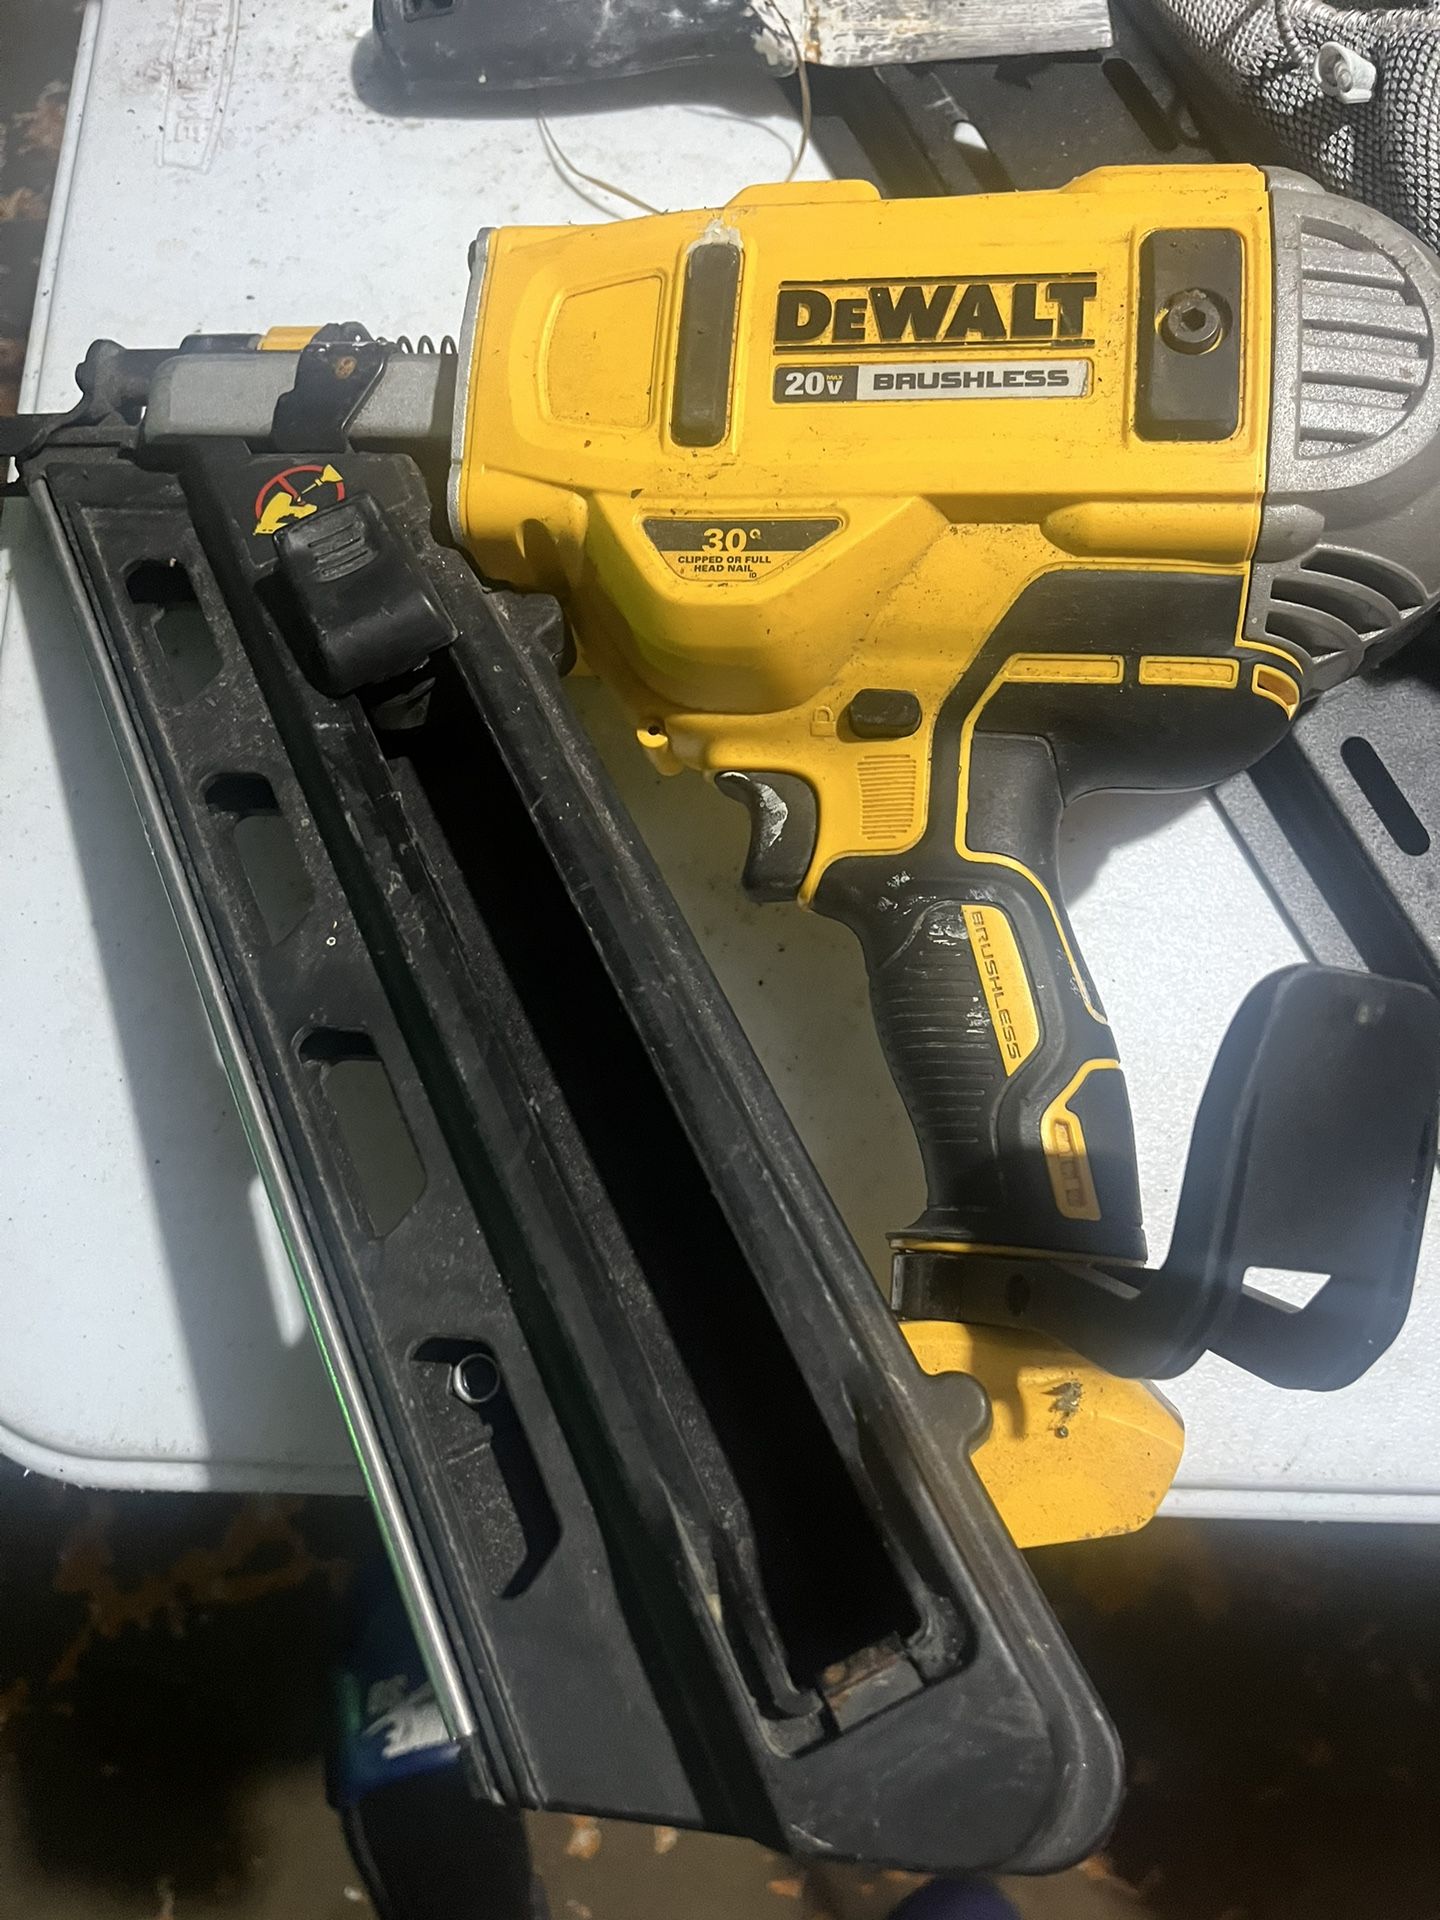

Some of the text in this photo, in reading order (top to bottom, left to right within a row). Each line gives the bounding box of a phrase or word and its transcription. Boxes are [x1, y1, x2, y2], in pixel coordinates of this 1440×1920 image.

[873, 369, 1071, 391] BRUSHLESS
[702, 528, 761, 553] 30°
[678, 556, 771, 564] CLIPPED OR FULL
[972, 911, 1021, 1059] BRUSHLESS
